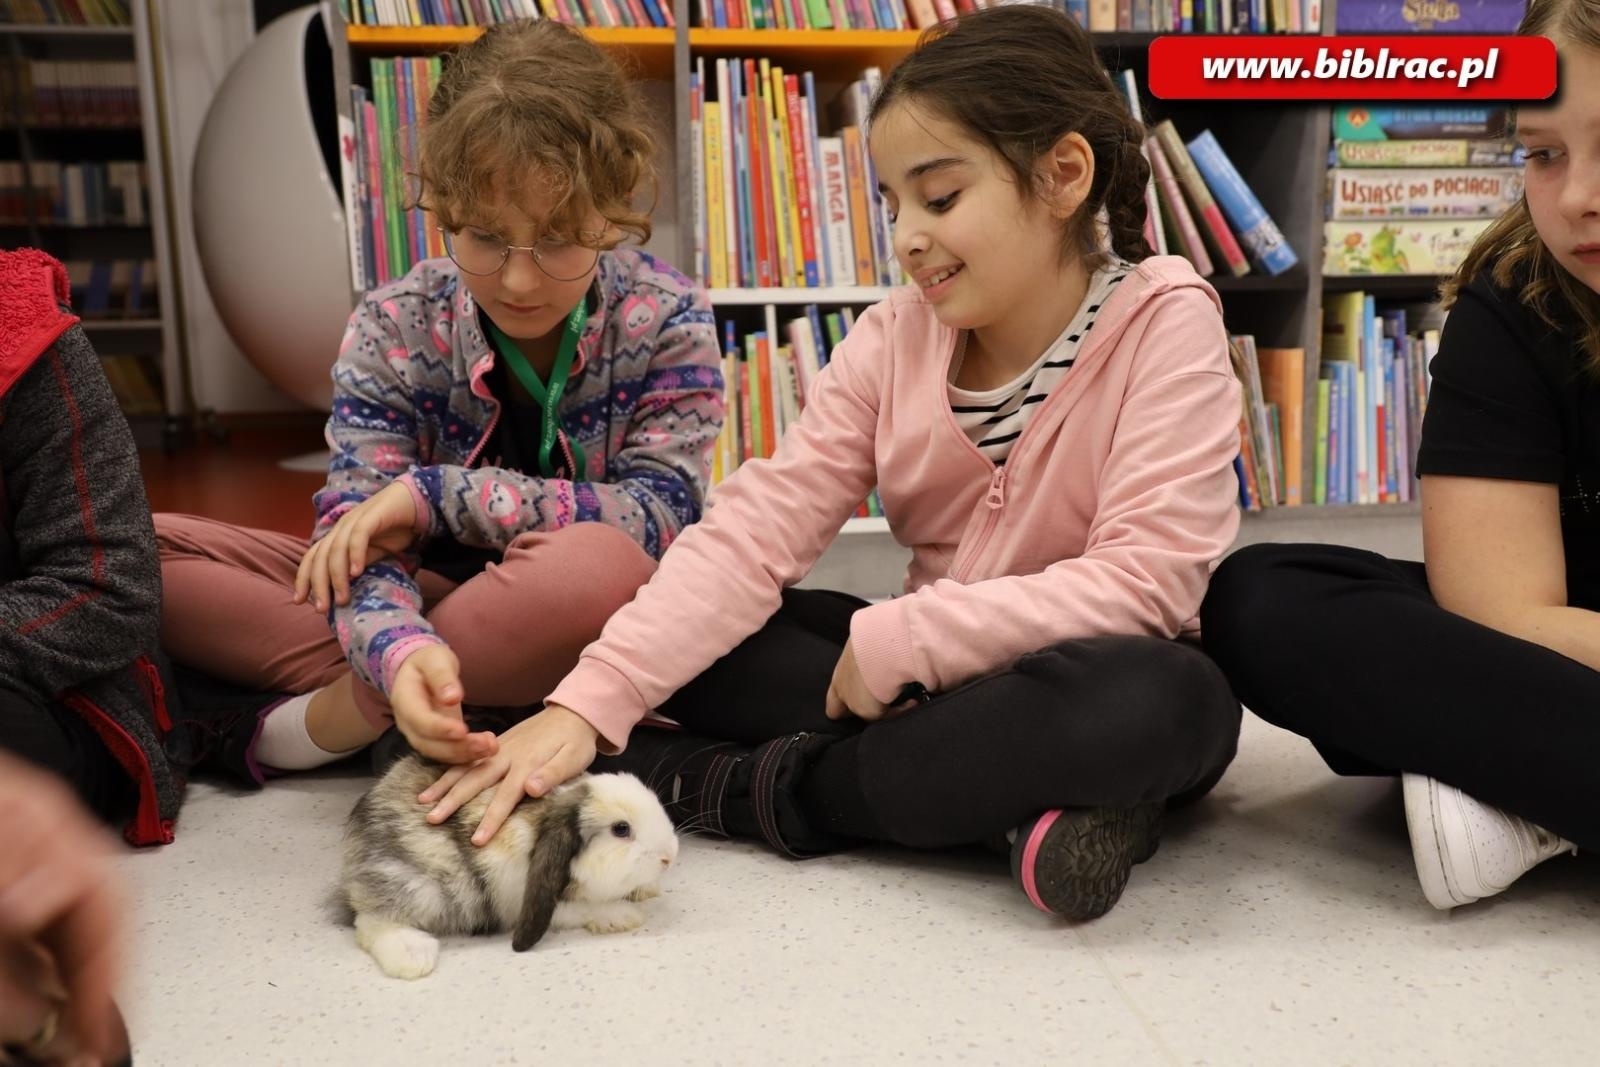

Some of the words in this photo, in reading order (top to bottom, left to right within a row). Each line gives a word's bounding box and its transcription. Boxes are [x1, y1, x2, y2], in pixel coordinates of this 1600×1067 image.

[824, 151, 845, 224] MANGA
[1408, 184, 1428, 198] DO
[1433, 176, 1500, 198] POCIĄGU
